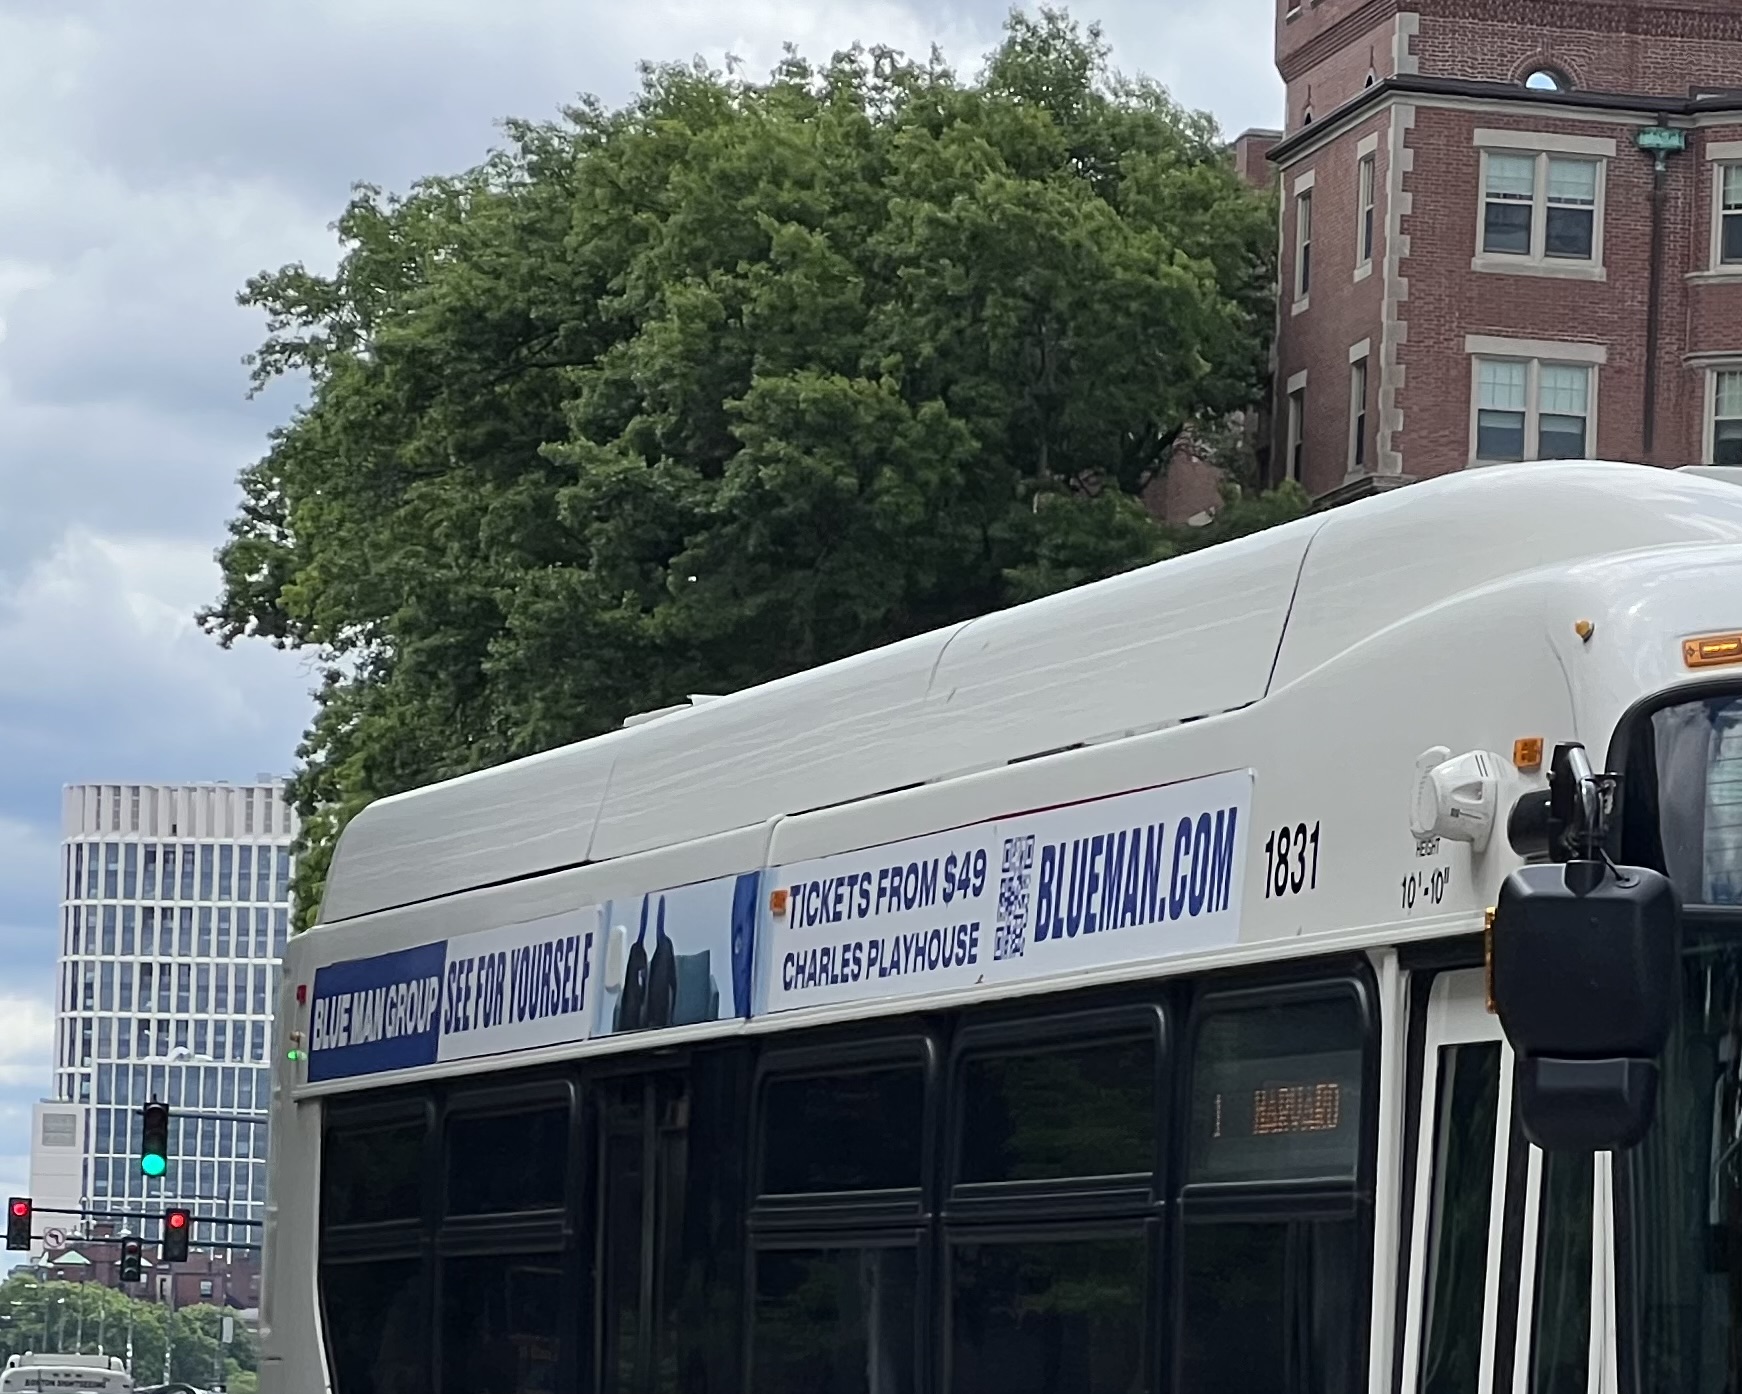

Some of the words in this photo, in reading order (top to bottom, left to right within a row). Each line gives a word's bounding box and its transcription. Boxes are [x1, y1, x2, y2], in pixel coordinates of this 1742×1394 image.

[789, 871, 871, 930] TICKETS
[876, 858, 940, 915] FROM
[943, 848, 988, 909] $49
[1034, 806, 1238, 942] BLUEMAN.COM
[1265, 820, 1320, 899] 1831
[444, 956, 474, 1035] SEE
[474, 951, 507, 1030] FOR
[508, 932, 593, 1024] YOURSELF
[782, 938, 862, 991] CHARLES
[867, 922, 980, 979] PLAYHOUSE
[312, 993, 350, 1051] BLUE
[350, 985, 384, 1045] MAN
[386, 976, 439, 1040] GROUP
